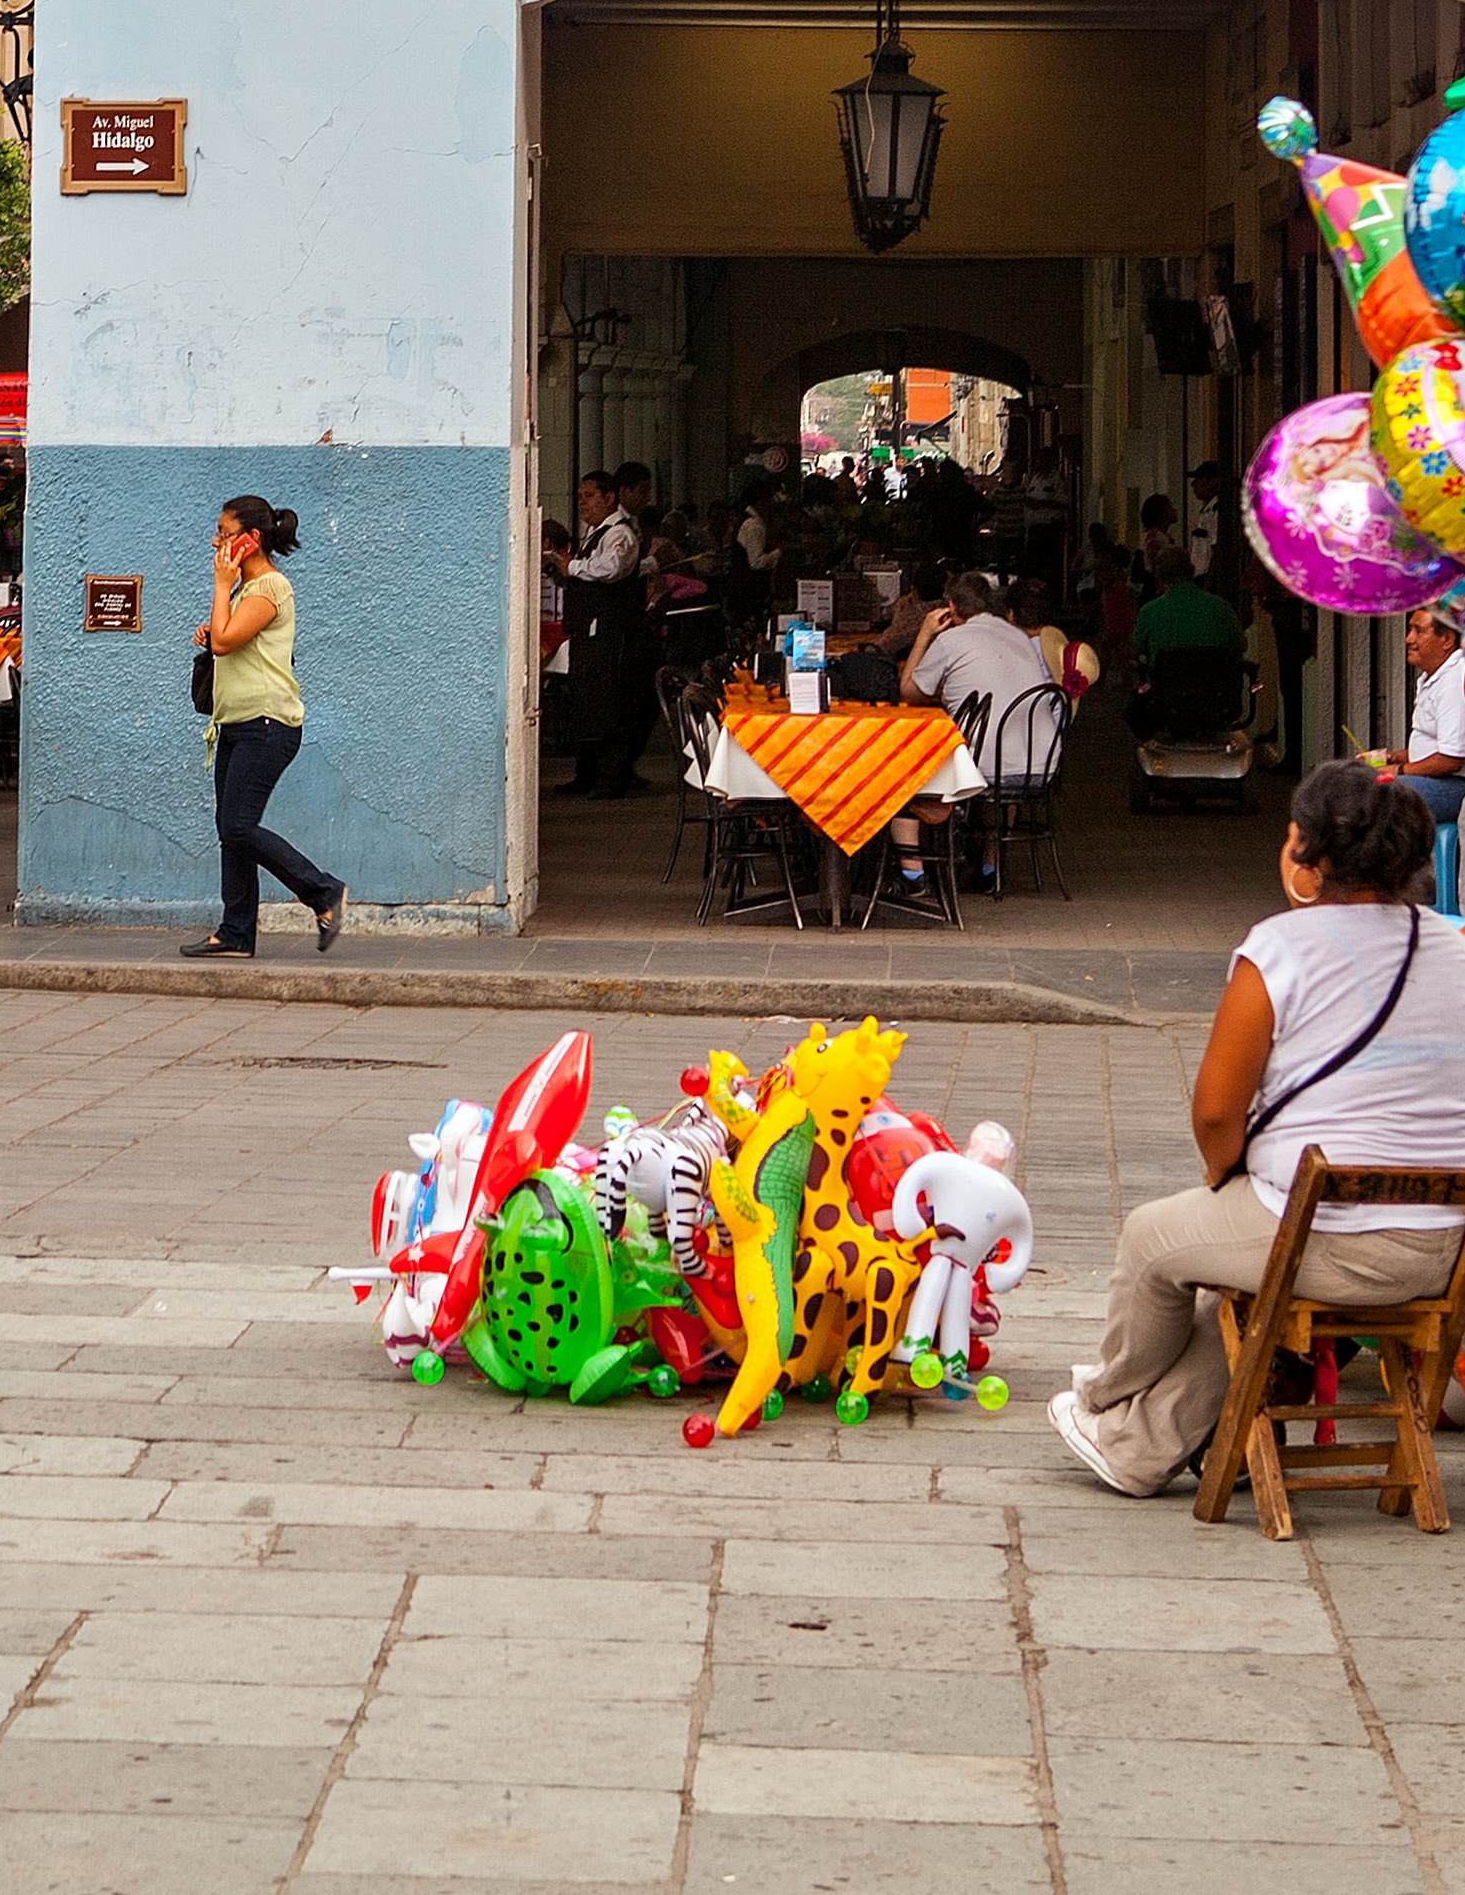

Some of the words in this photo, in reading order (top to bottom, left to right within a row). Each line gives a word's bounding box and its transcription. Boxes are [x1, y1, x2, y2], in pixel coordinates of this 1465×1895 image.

[92, 115, 112, 129] Av.
[114, 114, 155, 130] Miguel
[92, 131, 155, 152] Hidalgo
